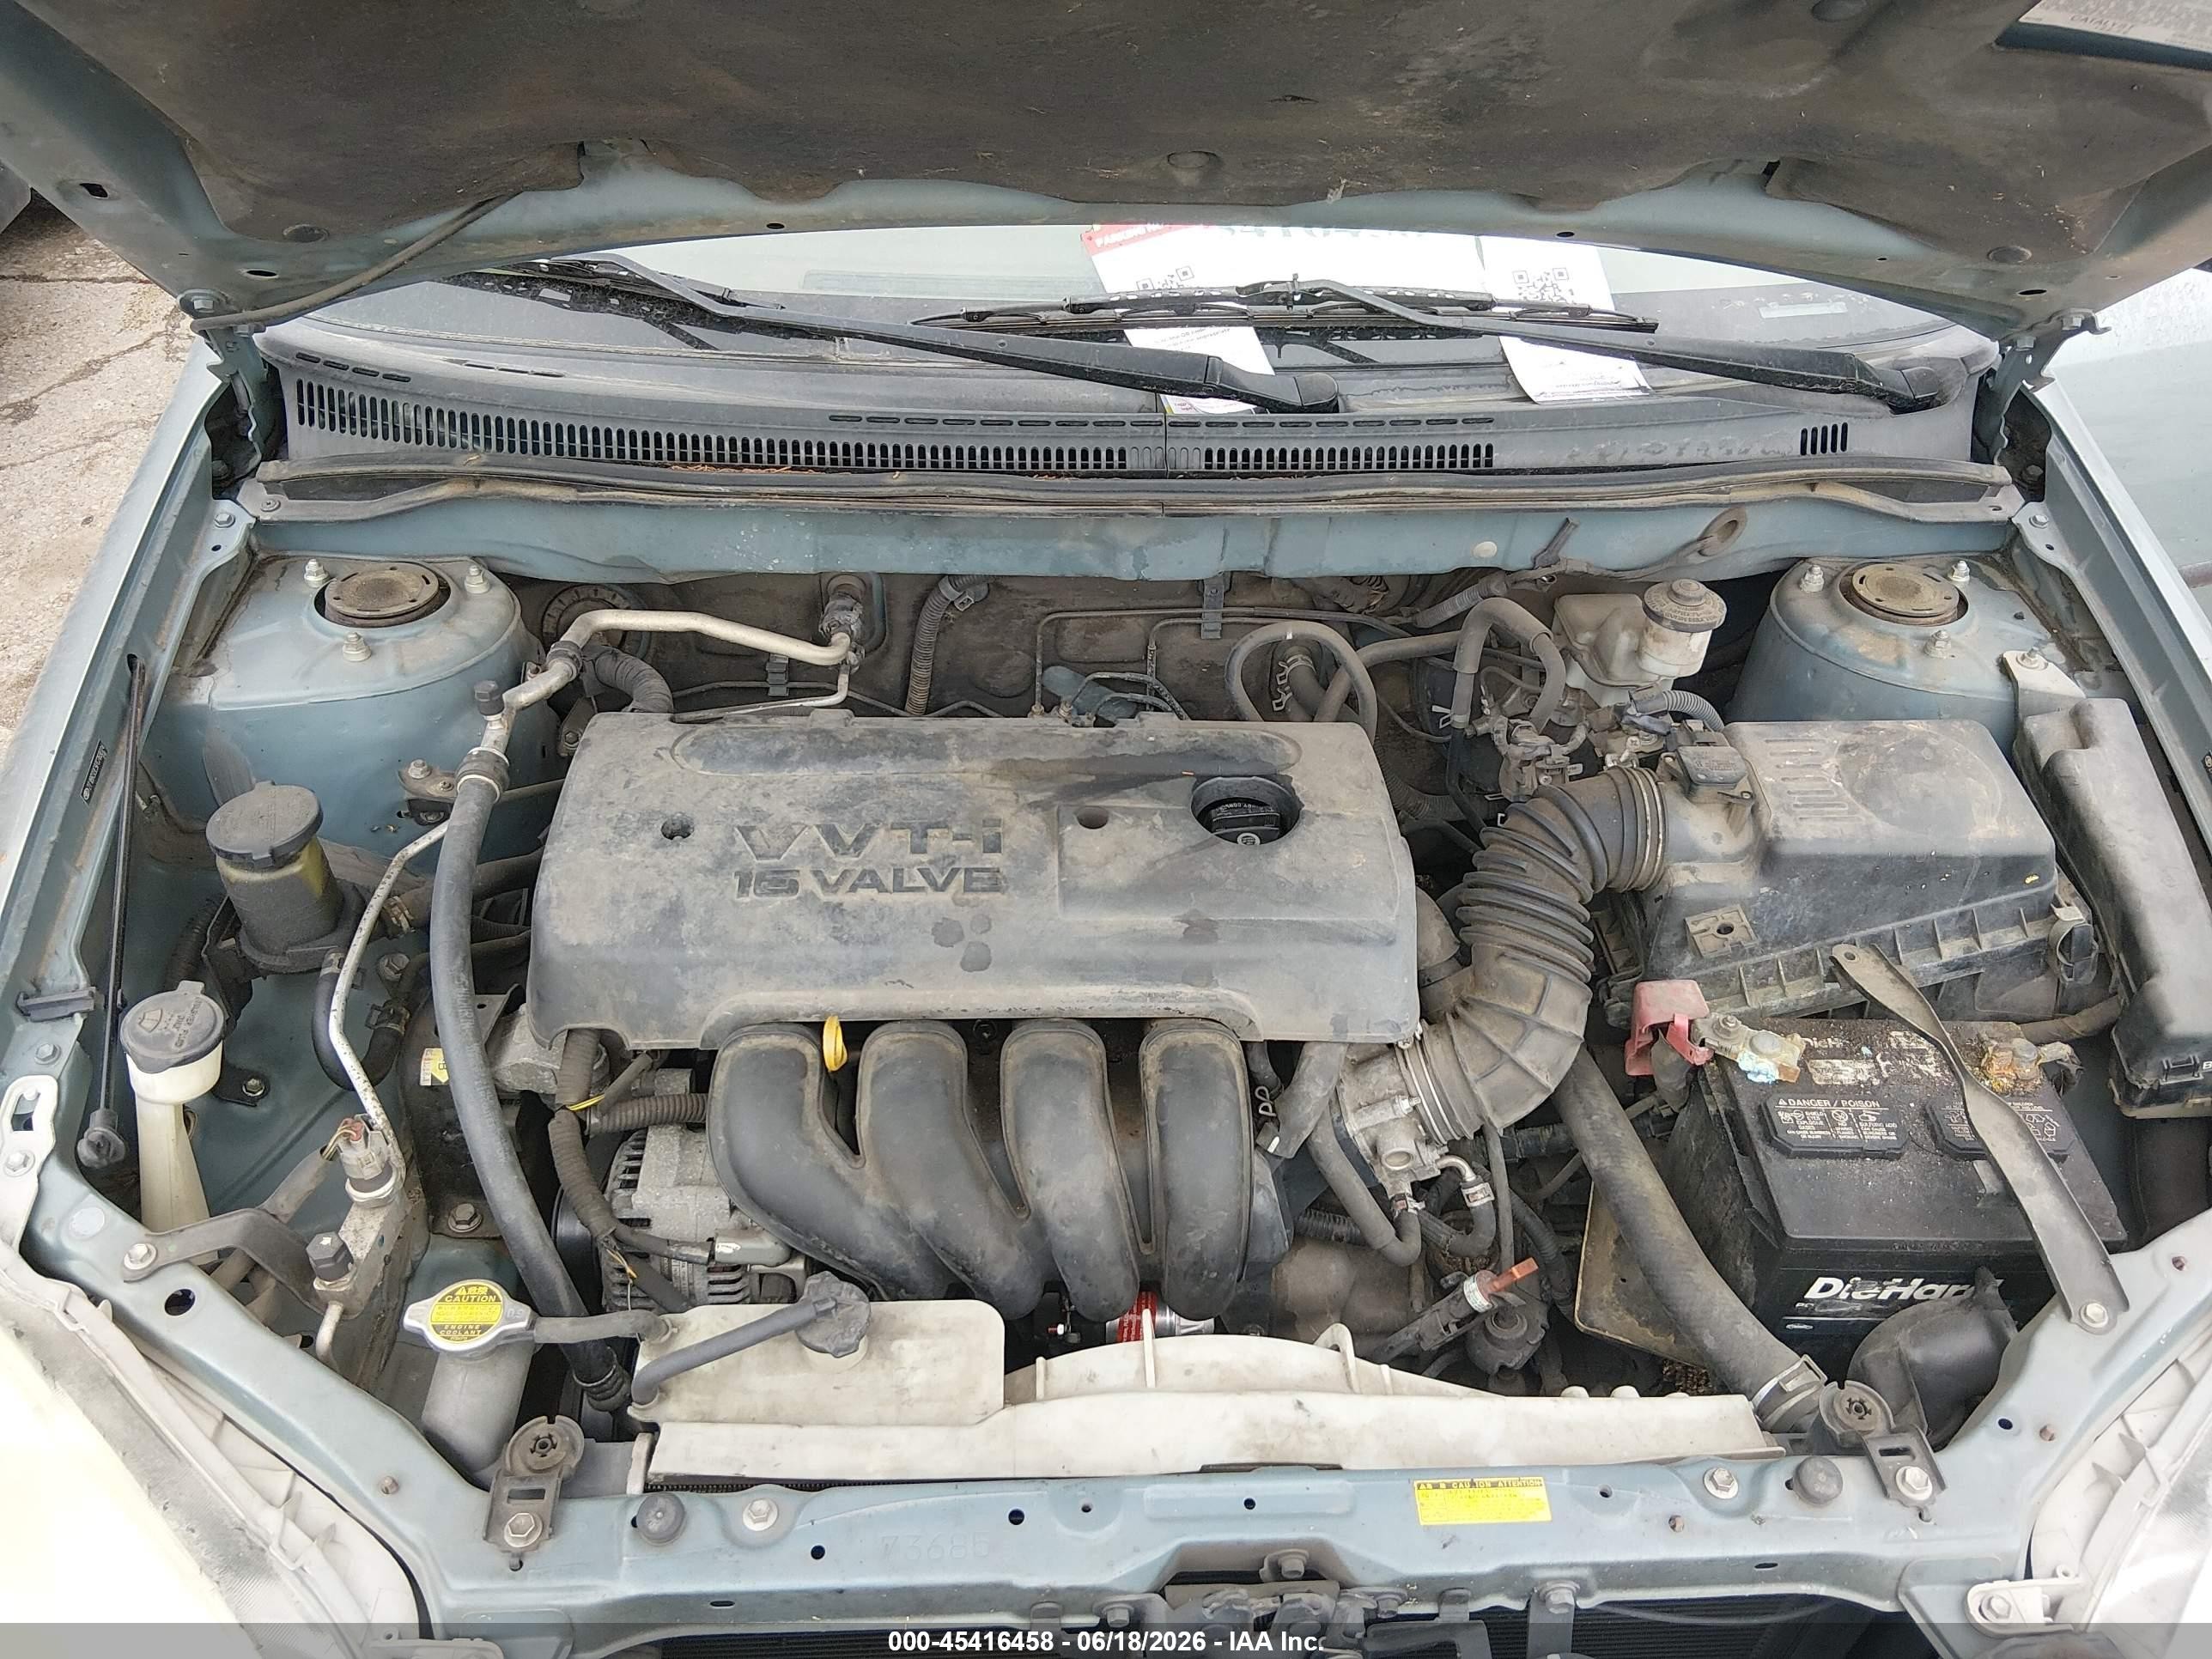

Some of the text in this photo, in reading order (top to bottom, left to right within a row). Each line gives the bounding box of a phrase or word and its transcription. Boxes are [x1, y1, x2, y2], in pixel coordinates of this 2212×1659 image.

[734, 866, 1005, 899] 16 VALVE
[1803, 1276, 2004, 1301] DieHar
[1451, 1480, 1492, 1489] CAUION
